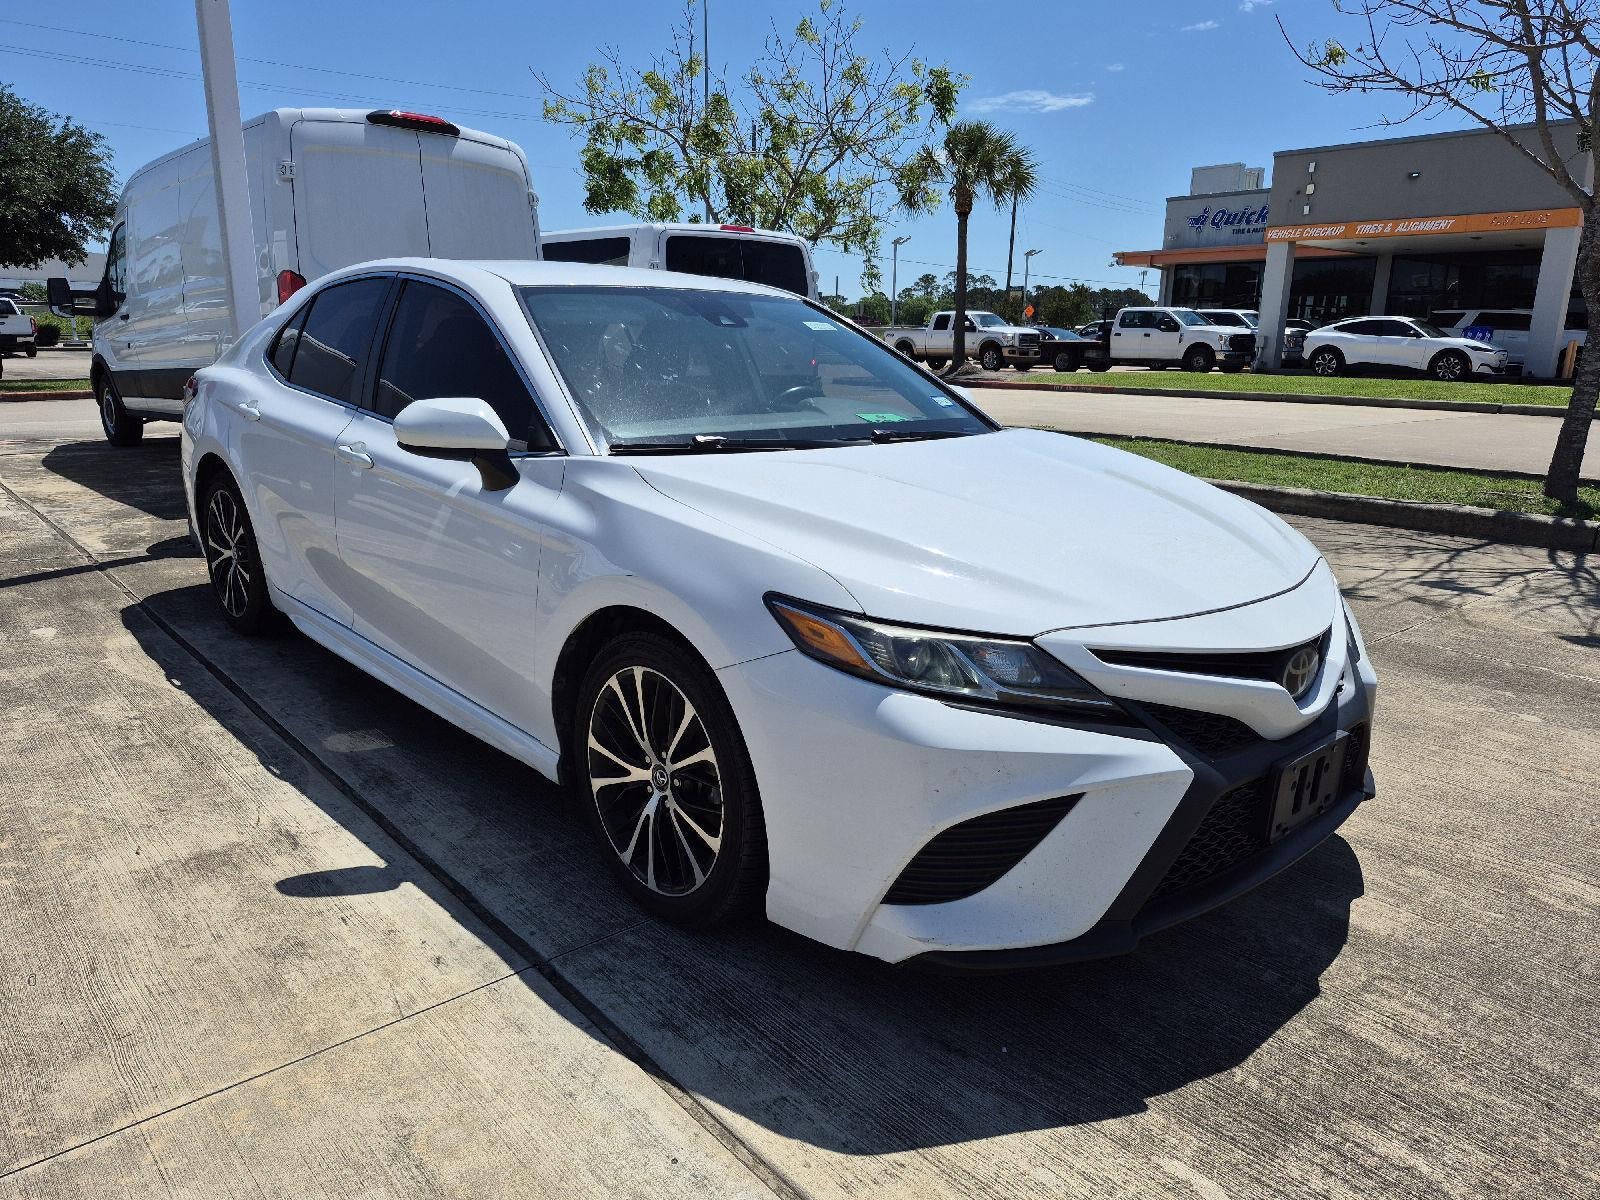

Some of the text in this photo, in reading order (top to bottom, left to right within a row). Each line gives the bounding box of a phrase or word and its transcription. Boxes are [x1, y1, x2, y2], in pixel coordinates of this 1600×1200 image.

[1210, 205, 1269, 229] Quick
[1267, 225, 1345, 239] VEHICLE CHECKUP
[1355, 218, 1456, 235] TIRES & ALIGNMENT
